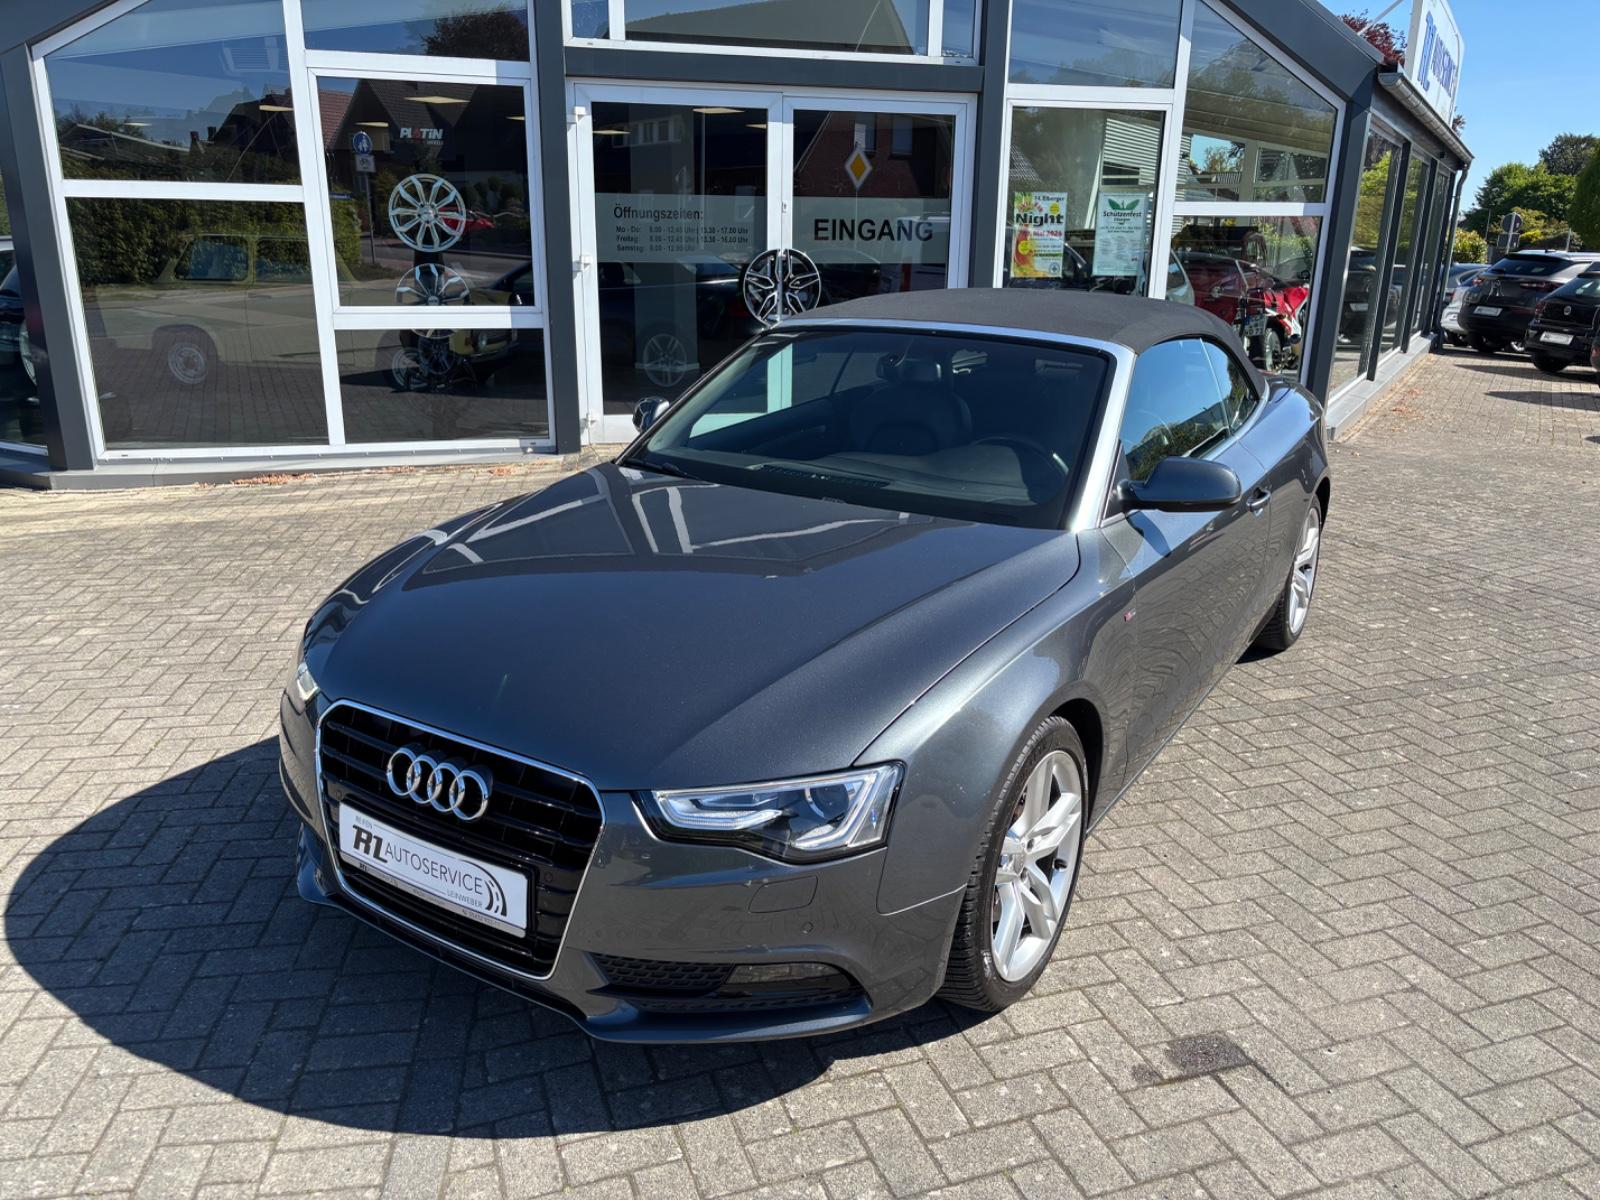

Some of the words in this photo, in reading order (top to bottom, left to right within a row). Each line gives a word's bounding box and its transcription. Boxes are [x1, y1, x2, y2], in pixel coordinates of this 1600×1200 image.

[613, 202, 704, 223] Öffnungszeiten:
[1015, 212, 1064, 227] Night
[814, 218, 933, 241] EINGANG
[384, 842, 483, 896] AUTOSERVICE
